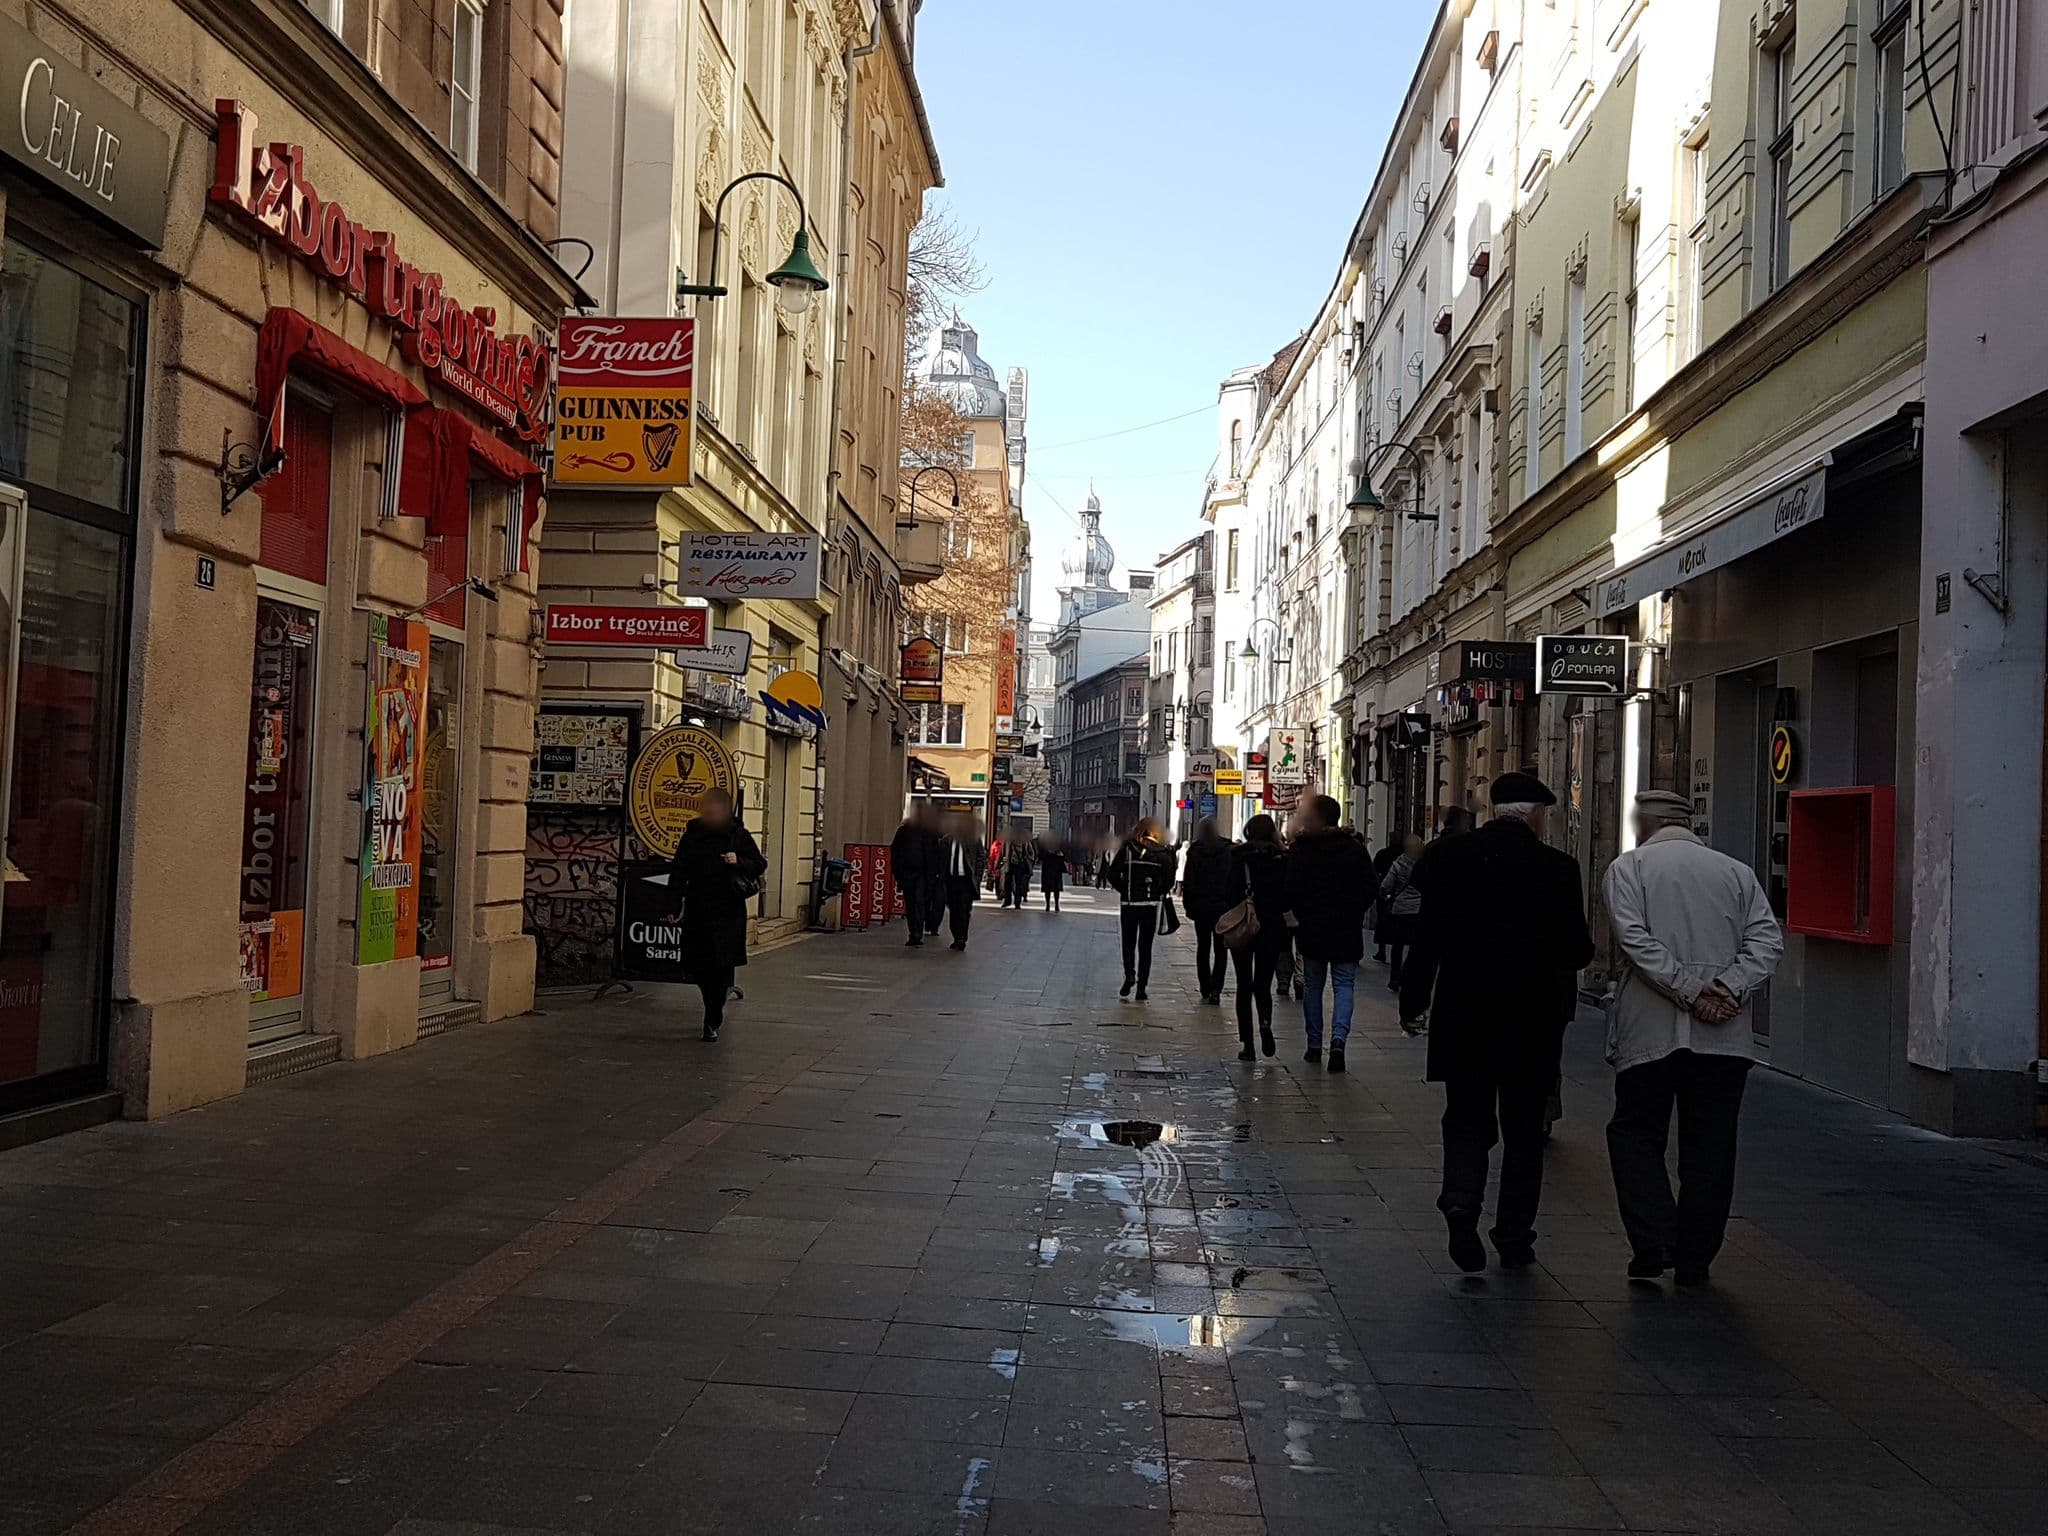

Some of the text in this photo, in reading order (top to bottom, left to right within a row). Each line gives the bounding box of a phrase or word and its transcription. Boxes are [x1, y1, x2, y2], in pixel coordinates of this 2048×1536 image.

[21, 58, 121, 201] CELJE
[209, 99, 537, 414] Izbor trgovine
[561, 325, 693, 361] Franck
[444, 360, 518, 428] World of beauty
[559, 397, 689, 420] GUINNESS
[560, 424, 606, 441] PUB
[690, 535, 811, 548] HOTEL ART
[201, 560, 212, 584] 26
[551, 613, 690, 635] Izbor trgovine
[639, 747, 663, 790] GUINNESS
[660, 733, 697, 750] SPECIAL
[697, 736, 724, 770] EXPORT
[1192, 761, 1211, 773] dm
[382, 783, 407, 821] NO
[241, 807, 277, 915] Izbor
[381, 824, 403, 862] VA
